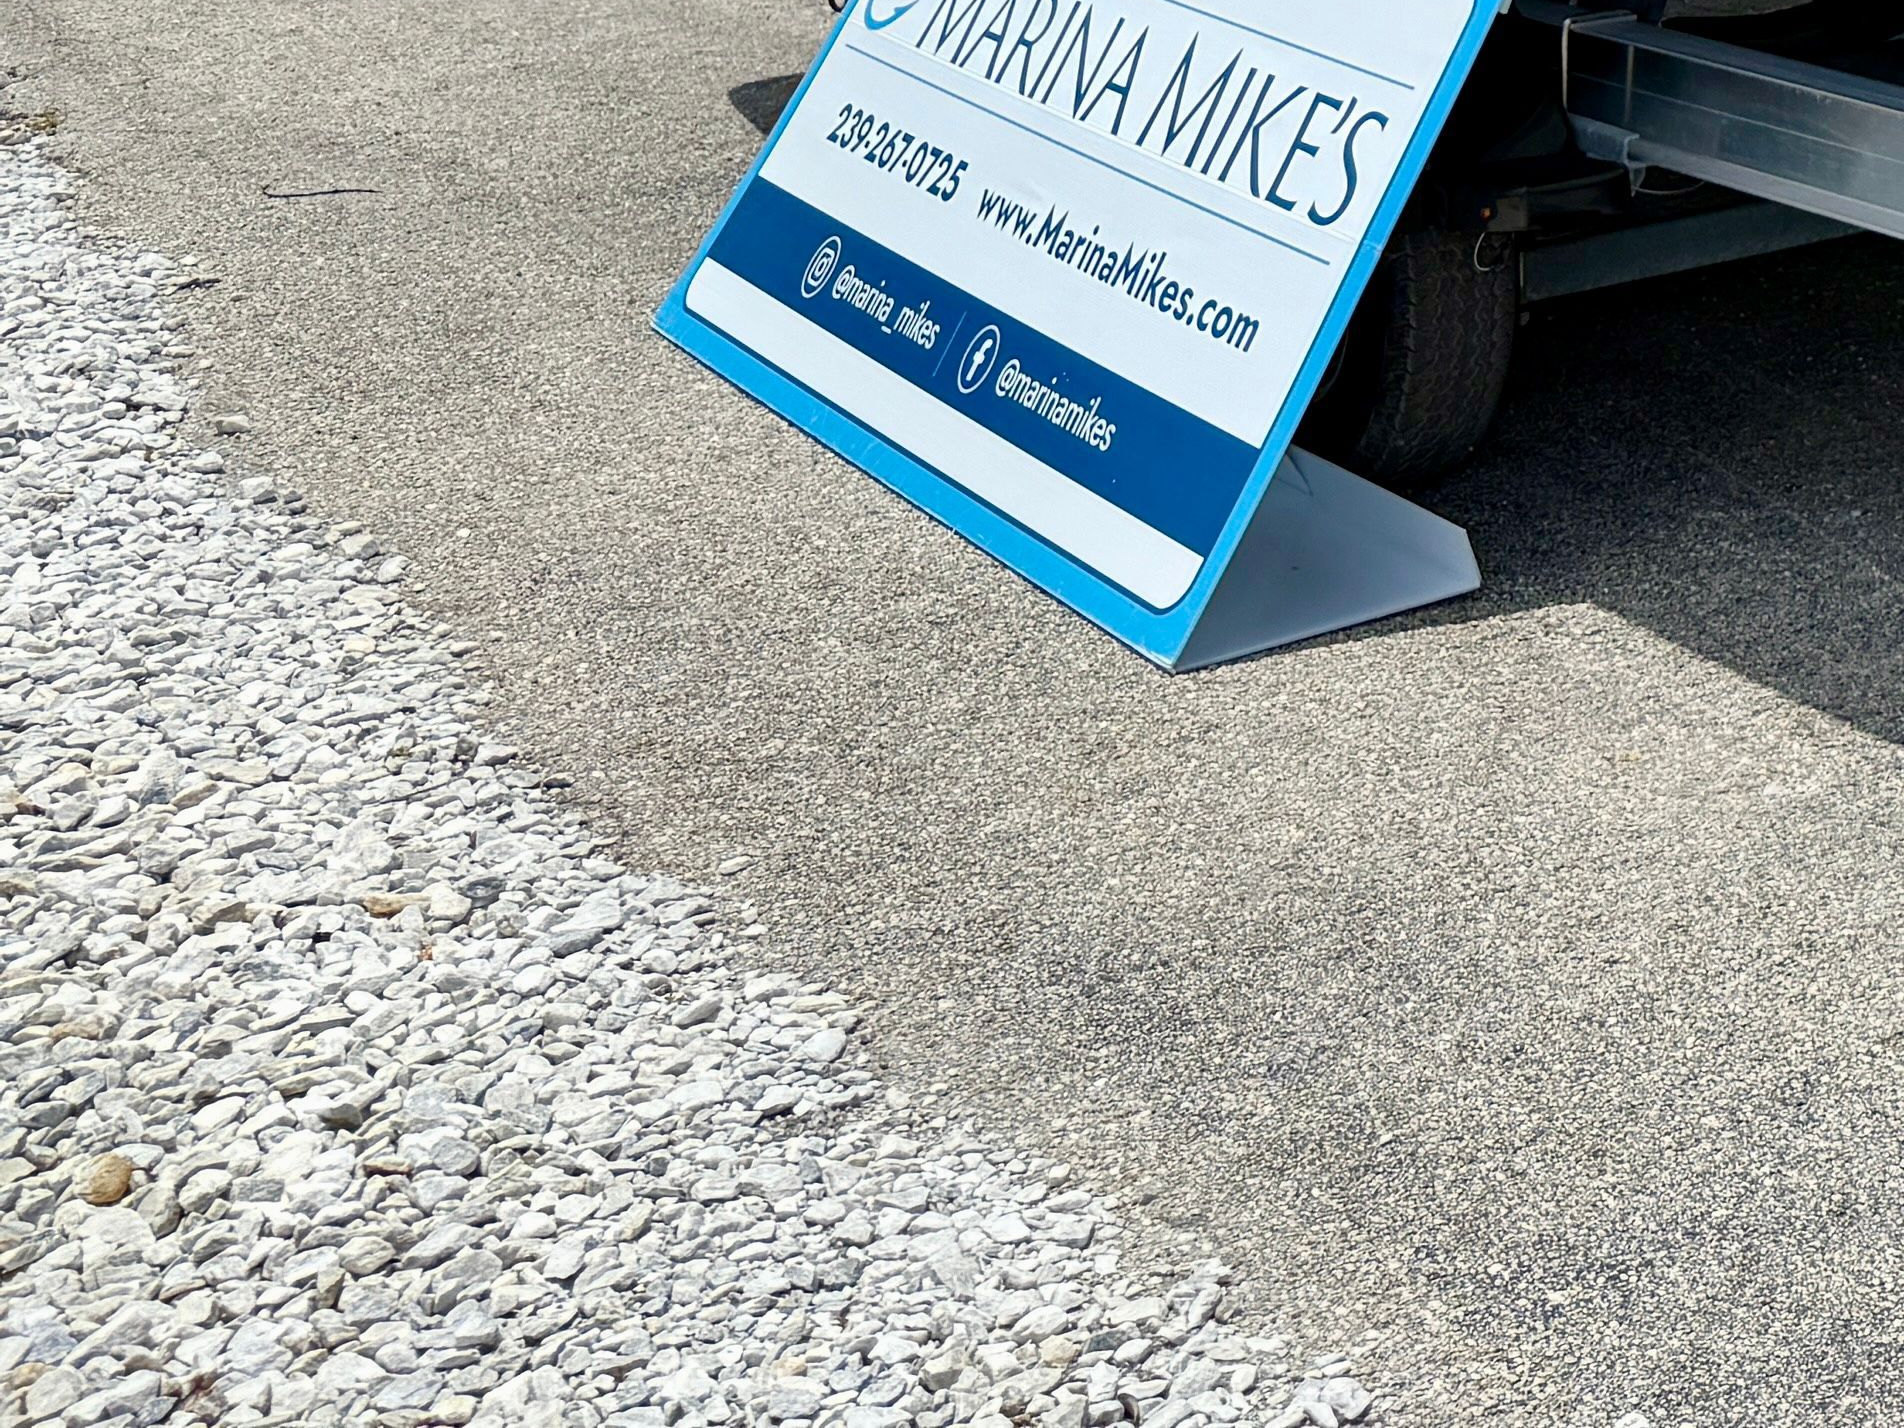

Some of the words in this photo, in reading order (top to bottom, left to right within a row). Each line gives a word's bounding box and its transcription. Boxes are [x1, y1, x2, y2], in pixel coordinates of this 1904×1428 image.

[1134, 30, 1389, 226] MIKE'S
[825, 103, 969, 203] 239-267-0725
[977, 187, 1260, 353] www.MarinaMikes.com
[832, 263, 941, 351] @marina_mikes
[995, 357, 1117, 452] @marinamikes
